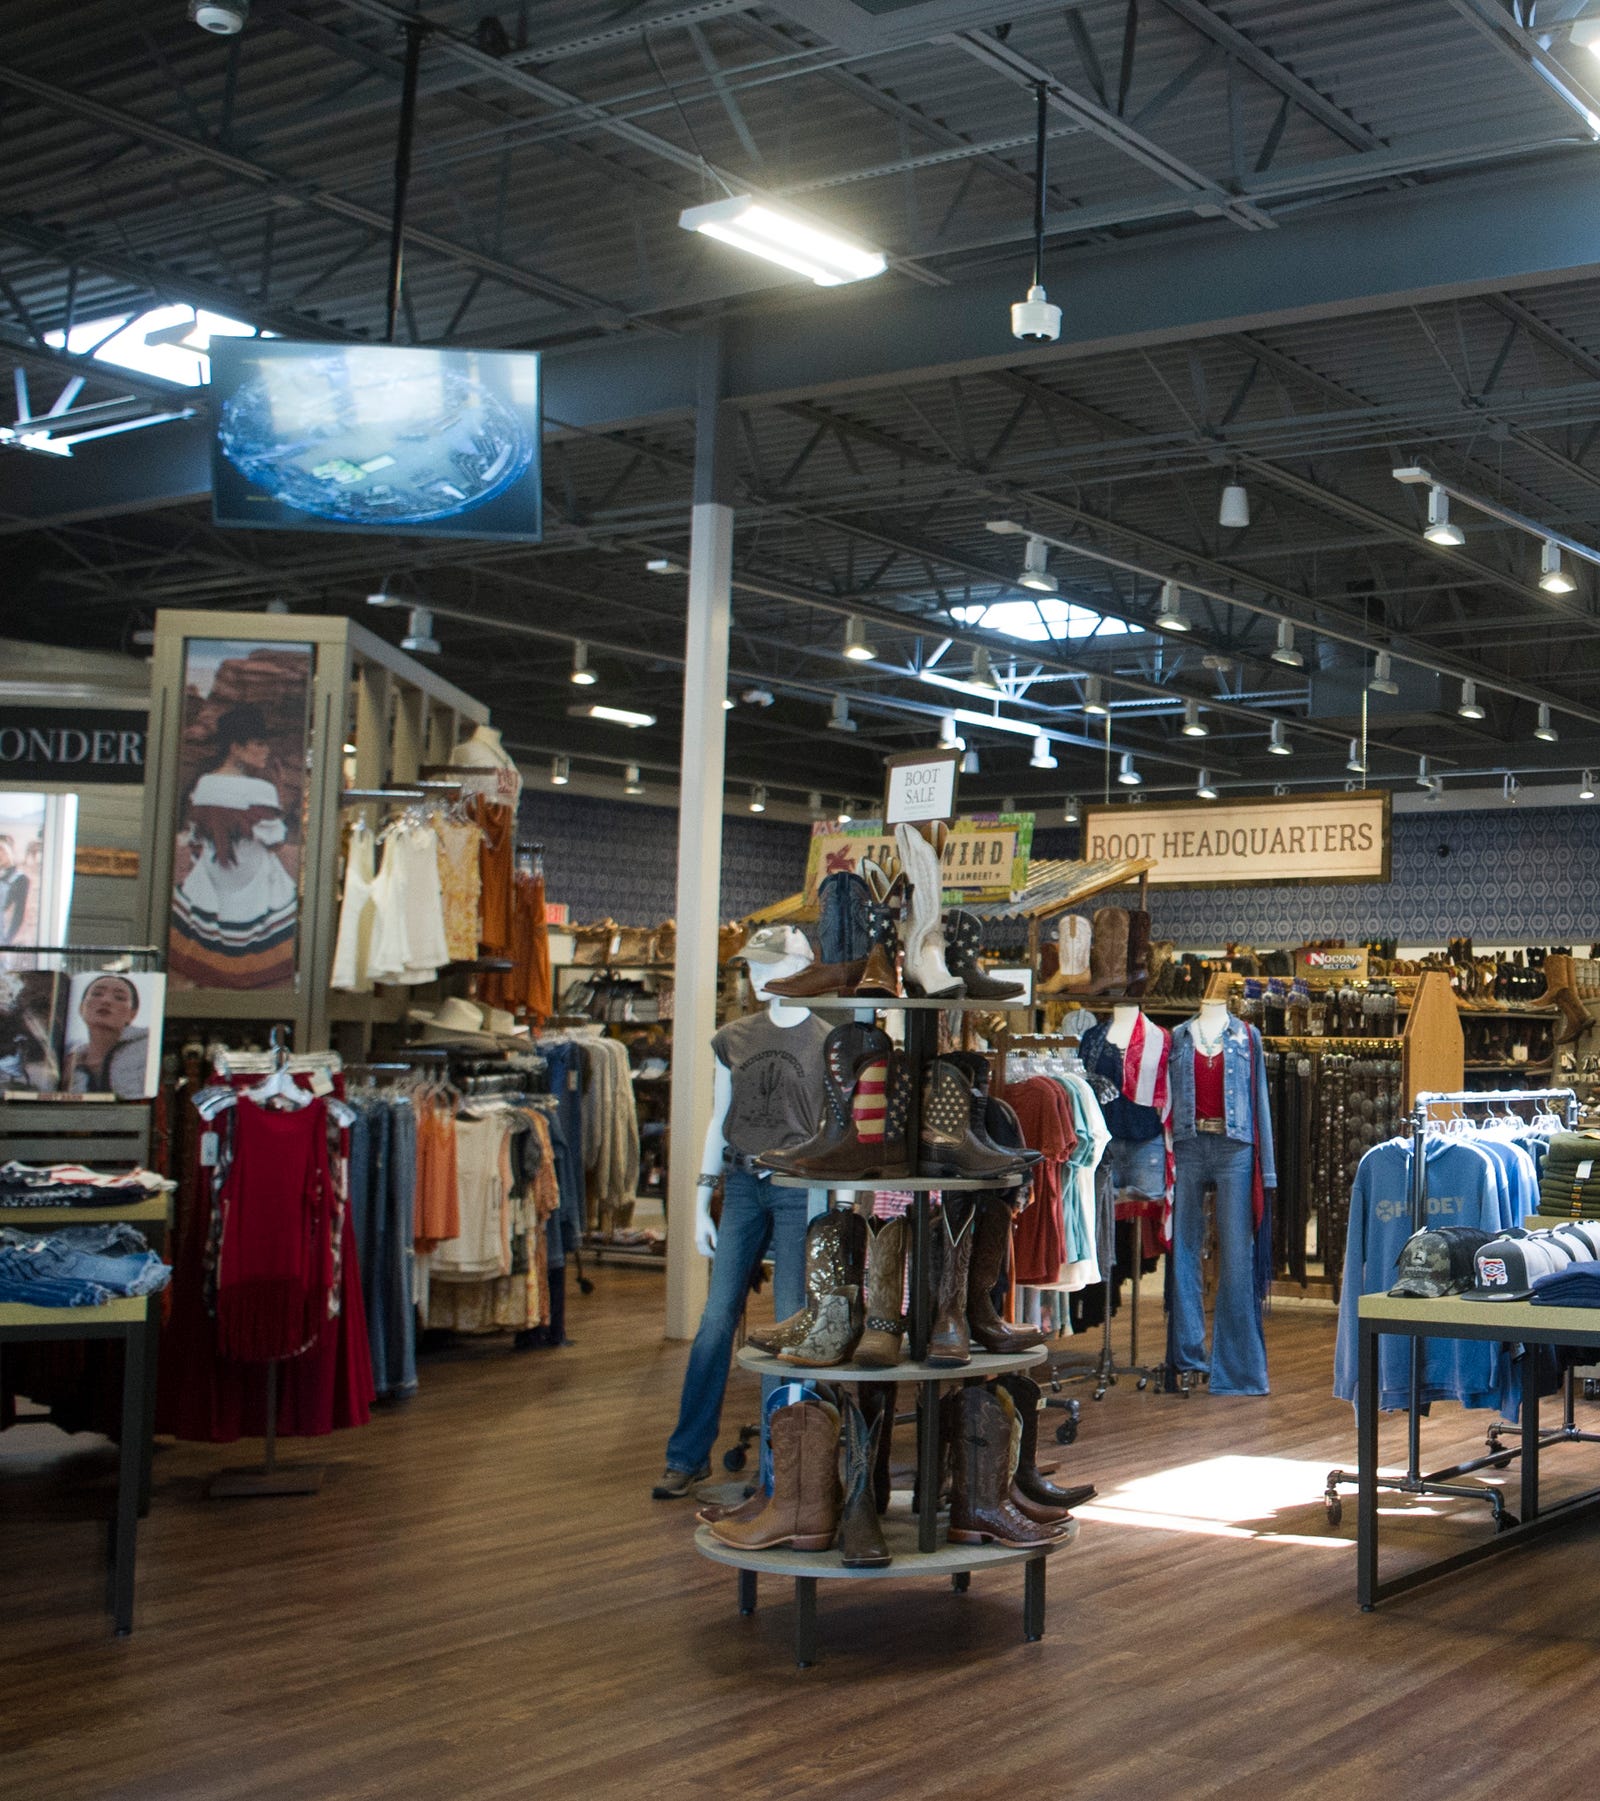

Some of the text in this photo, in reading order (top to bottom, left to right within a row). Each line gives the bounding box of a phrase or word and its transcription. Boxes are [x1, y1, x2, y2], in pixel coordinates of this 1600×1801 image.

[0, 727, 146, 765] ONDER
[905, 768, 940, 786] BOOT
[905, 787, 935, 804] SALE
[1092, 823, 1373, 860] BOOT HEADQUARTERS
[1310, 952, 1363, 966] NOCONA
[1394, 1197, 1464, 1218] HOEY
